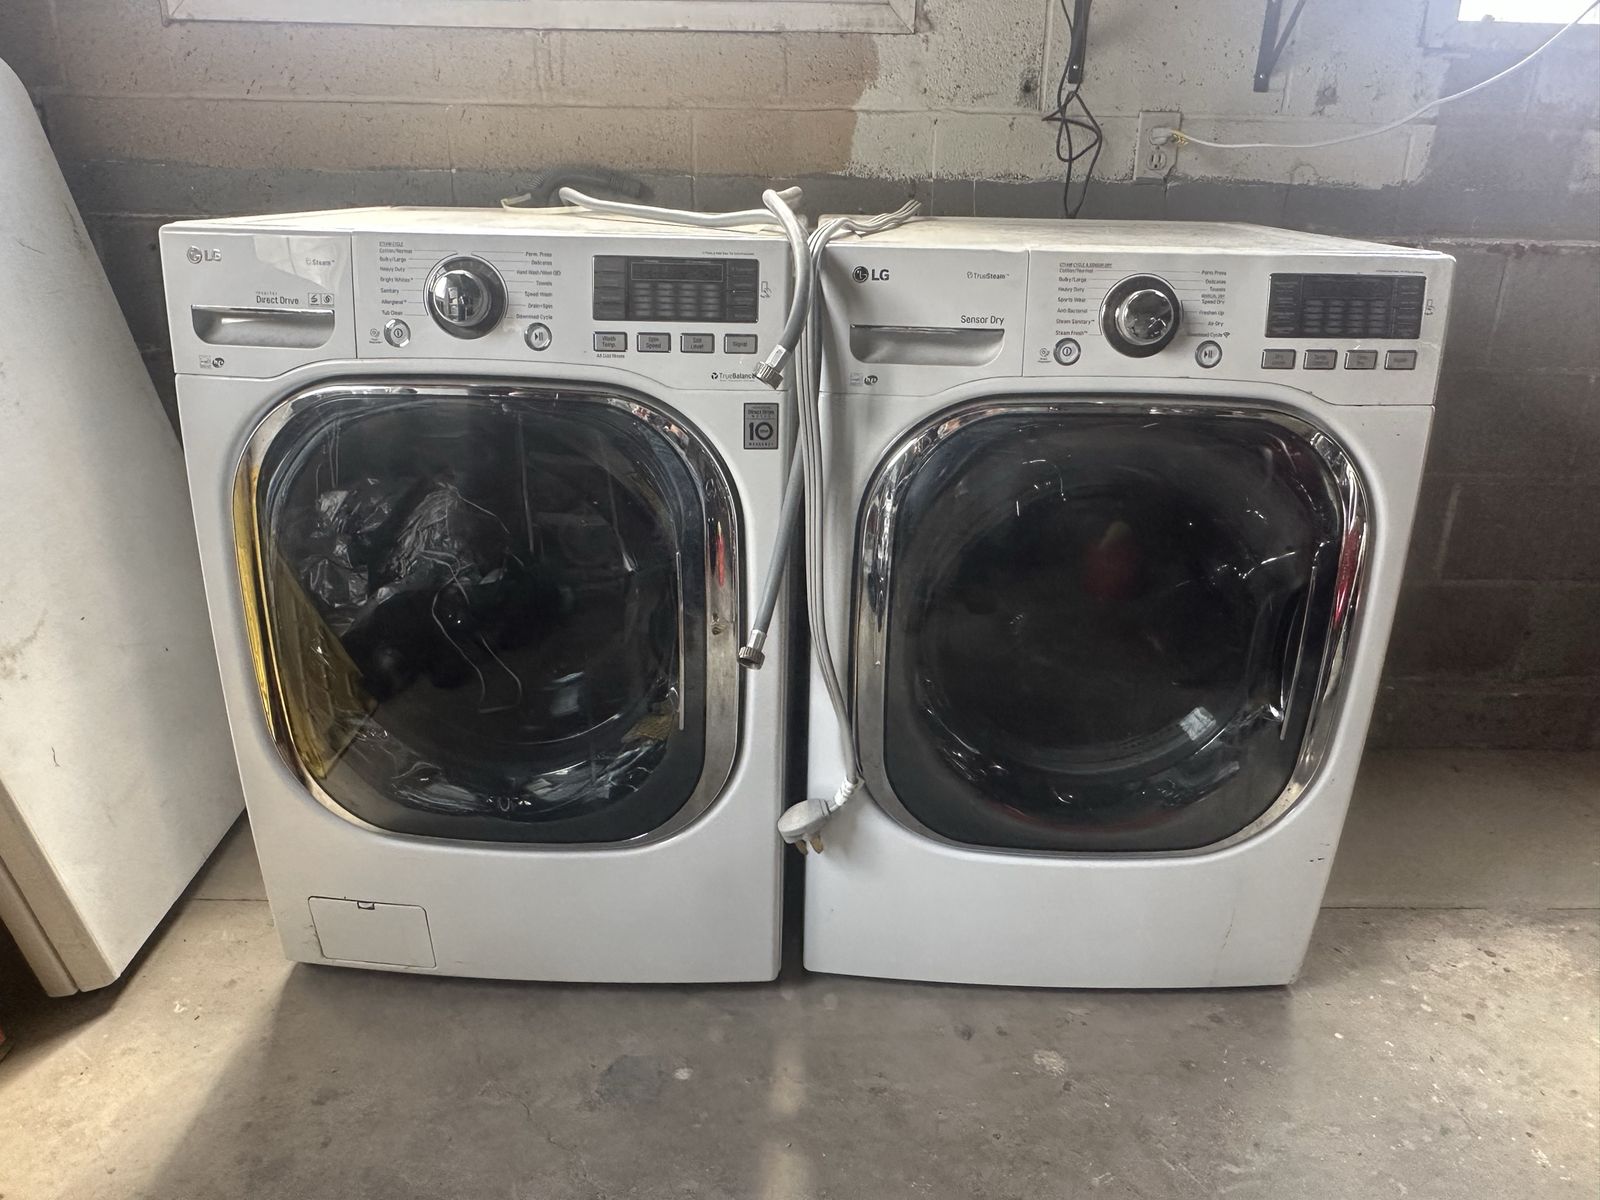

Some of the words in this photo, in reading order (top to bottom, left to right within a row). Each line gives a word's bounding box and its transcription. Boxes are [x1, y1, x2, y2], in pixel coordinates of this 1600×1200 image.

[204, 248, 222, 262] LG
[871, 269, 890, 281] LG
[256, 295, 279, 305] Direct
[279, 296, 299, 305] Drive
[960, 315, 988, 324] Sensor
[990, 316, 1005, 325] Dry
[748, 421, 774, 441] 10
